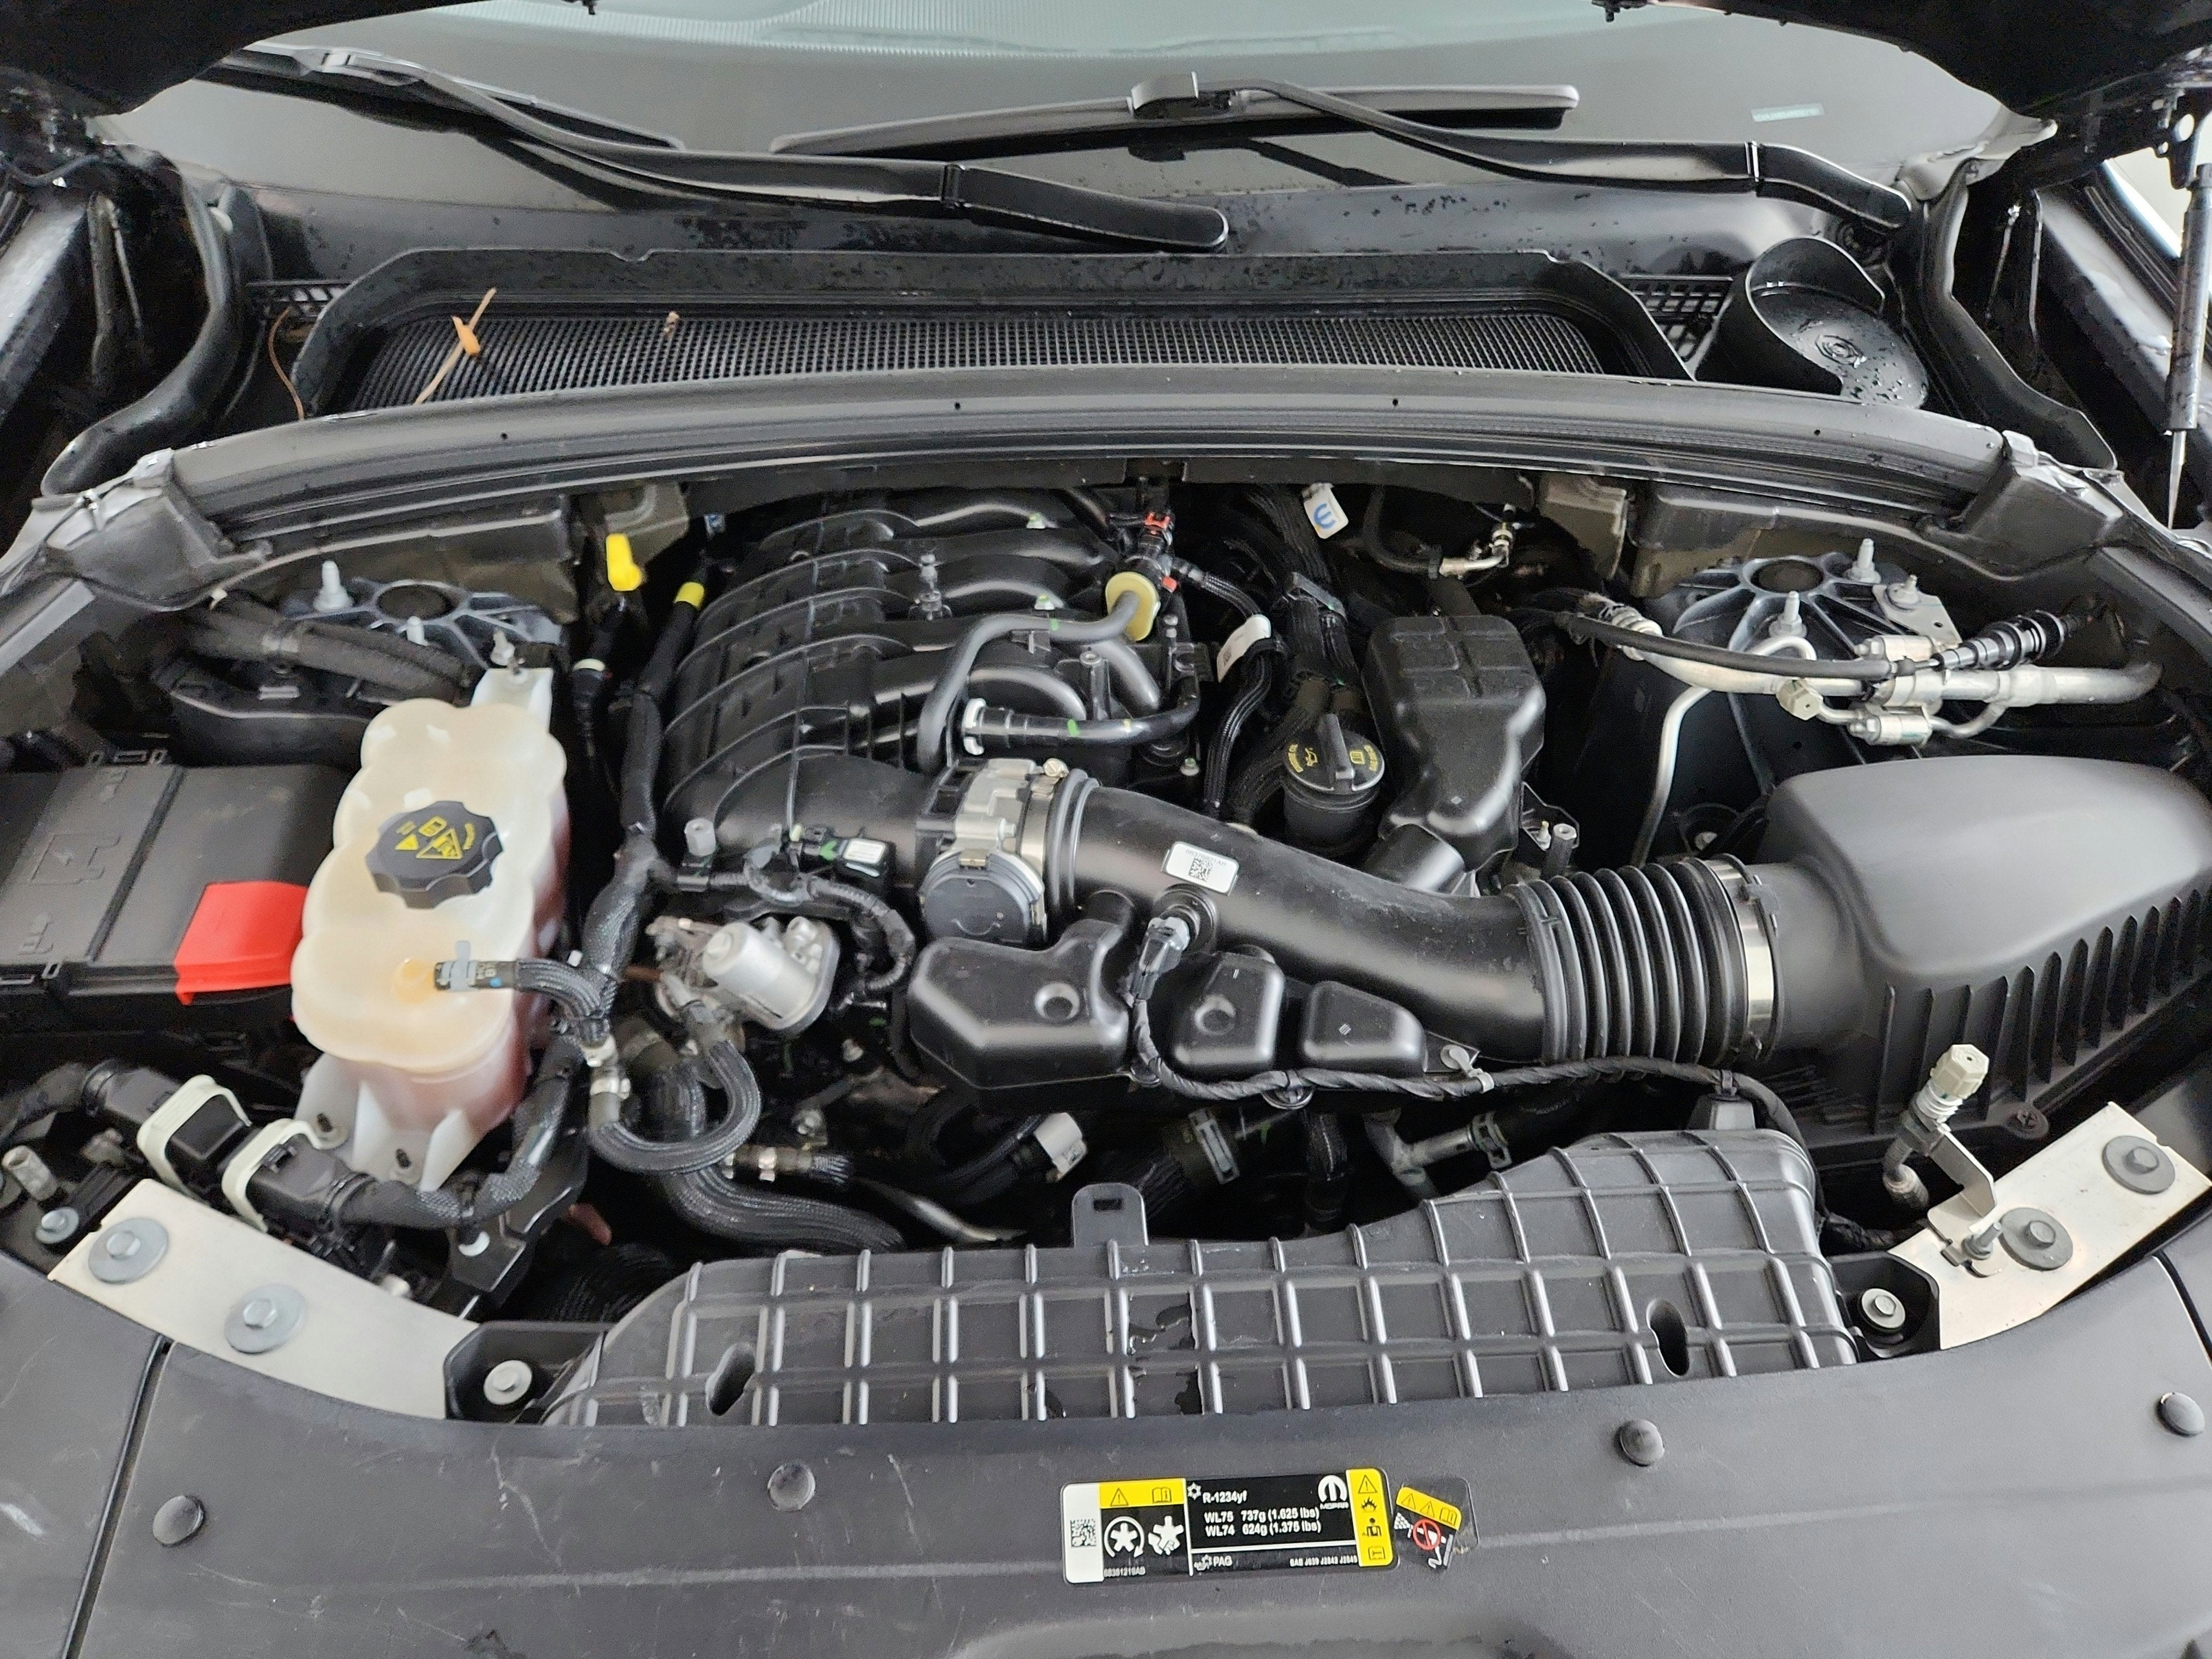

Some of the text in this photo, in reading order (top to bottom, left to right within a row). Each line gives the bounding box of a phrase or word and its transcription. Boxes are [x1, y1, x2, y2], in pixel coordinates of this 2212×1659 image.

[1203, 1490, 1248, 1504] R-1234yf
[1204, 1506, 1319, 1523] WL75 737g (1.625 lbs)
[1205, 1521, 1321, 1537] WL74 624g (1.375 lbs)
[1213, 1556, 1233, 1566] PAG
